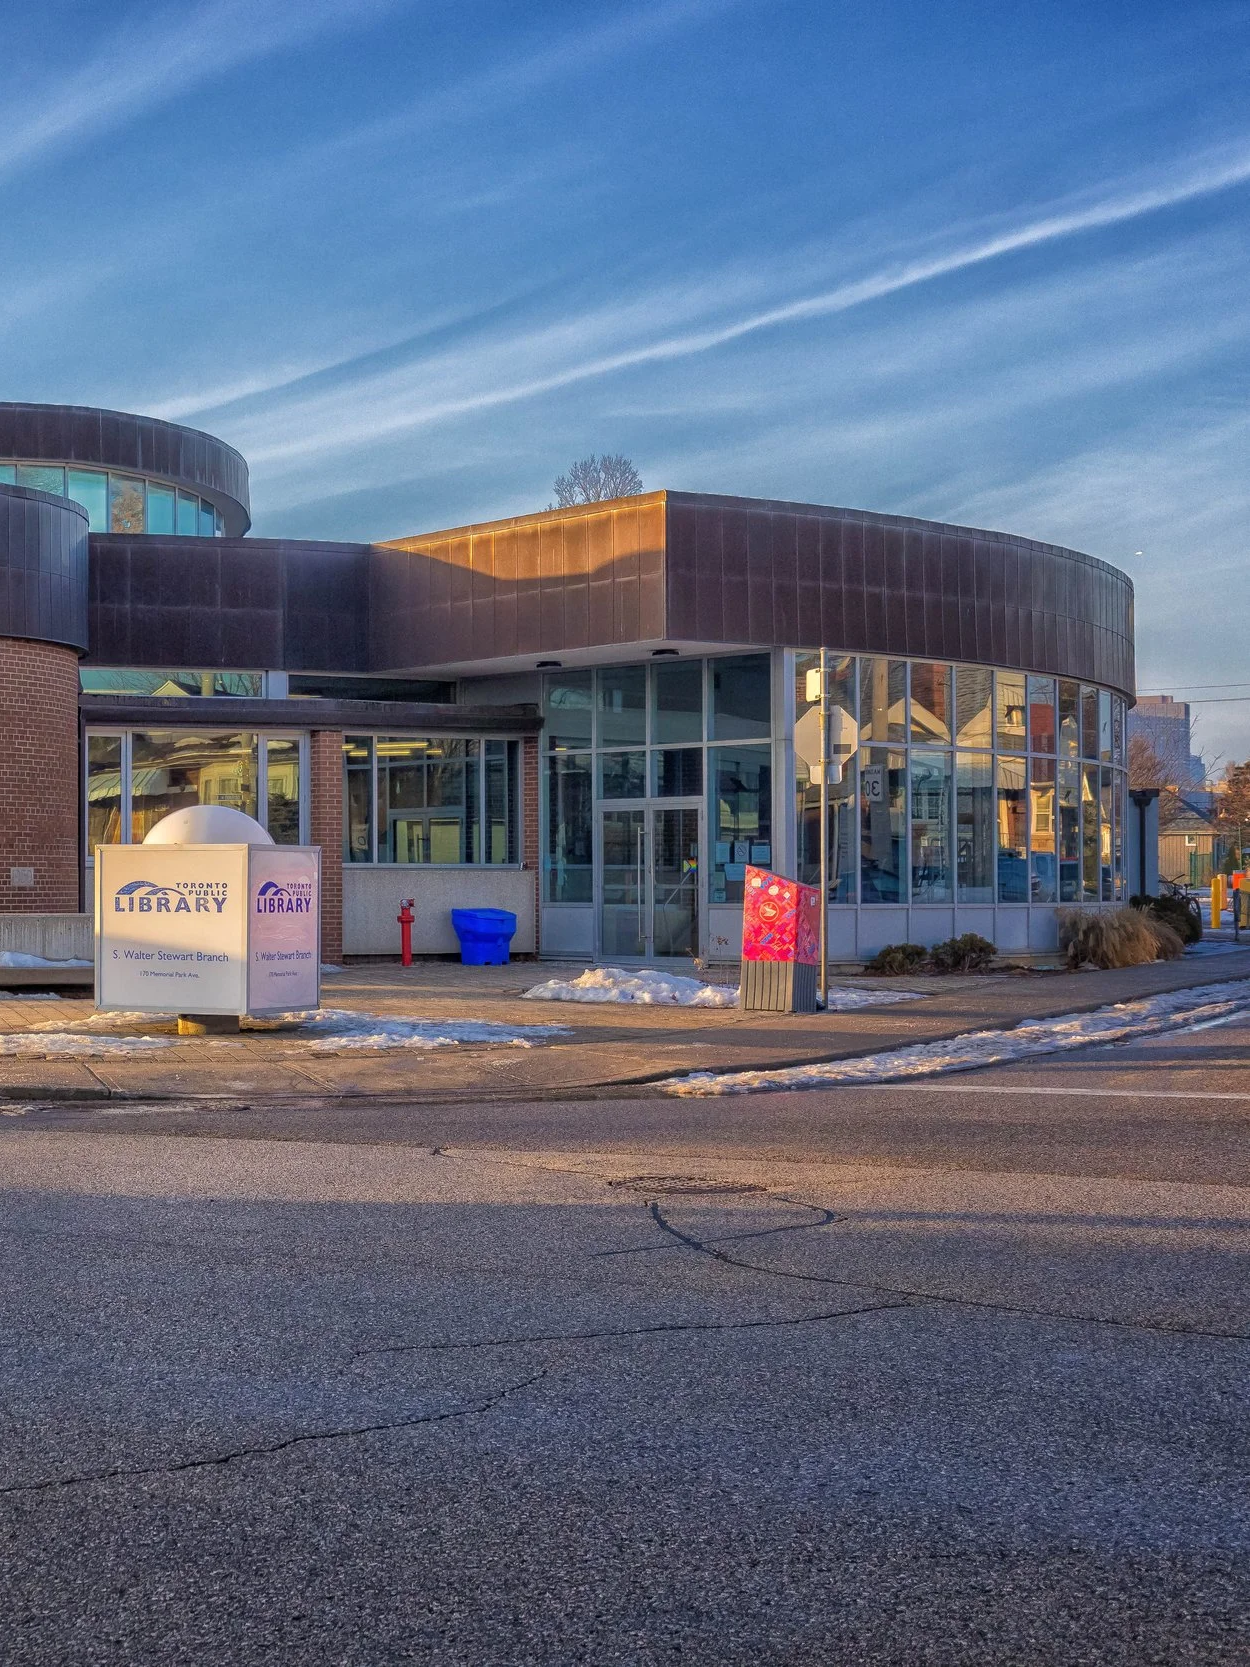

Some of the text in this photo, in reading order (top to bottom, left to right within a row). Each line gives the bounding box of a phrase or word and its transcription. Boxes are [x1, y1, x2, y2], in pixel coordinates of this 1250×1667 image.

[114, 897, 228, 913] LIBRARY
[257, 897, 312, 913] LIBRARY
[113, 950, 229, 962] S. Walter Stewart Branch
[261, 952, 277, 961] Walter
[277, 951, 295, 960] Stewart
[296, 950, 312, 959] Branch
